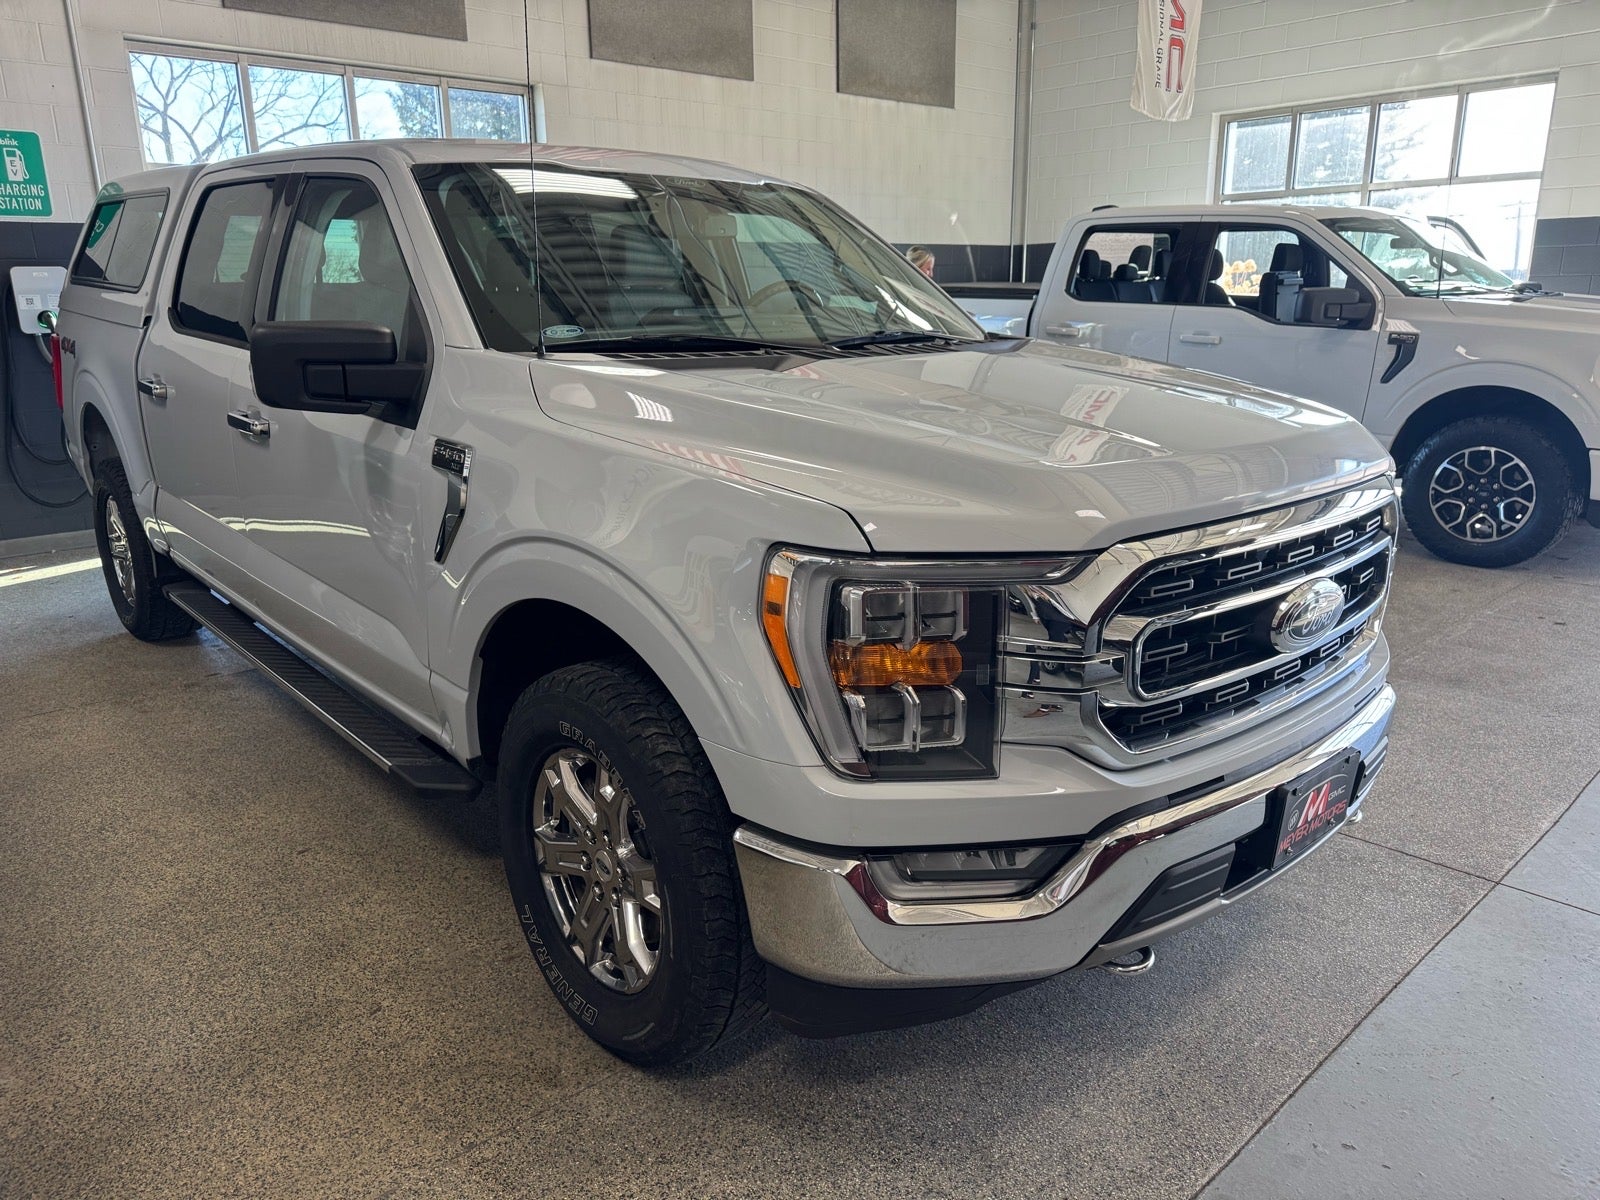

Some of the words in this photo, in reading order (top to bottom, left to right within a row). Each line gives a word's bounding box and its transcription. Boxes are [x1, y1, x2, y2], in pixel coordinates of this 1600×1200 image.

[0, 183, 45, 197] HARGING
[0, 197, 42, 211] STATION
[1302, 603, 1335, 635] Ford
[1278, 823, 1309, 855] MEYER
[1309, 801, 1346, 832] MOTORS
[521, 904, 598, 1026] GENERAL
